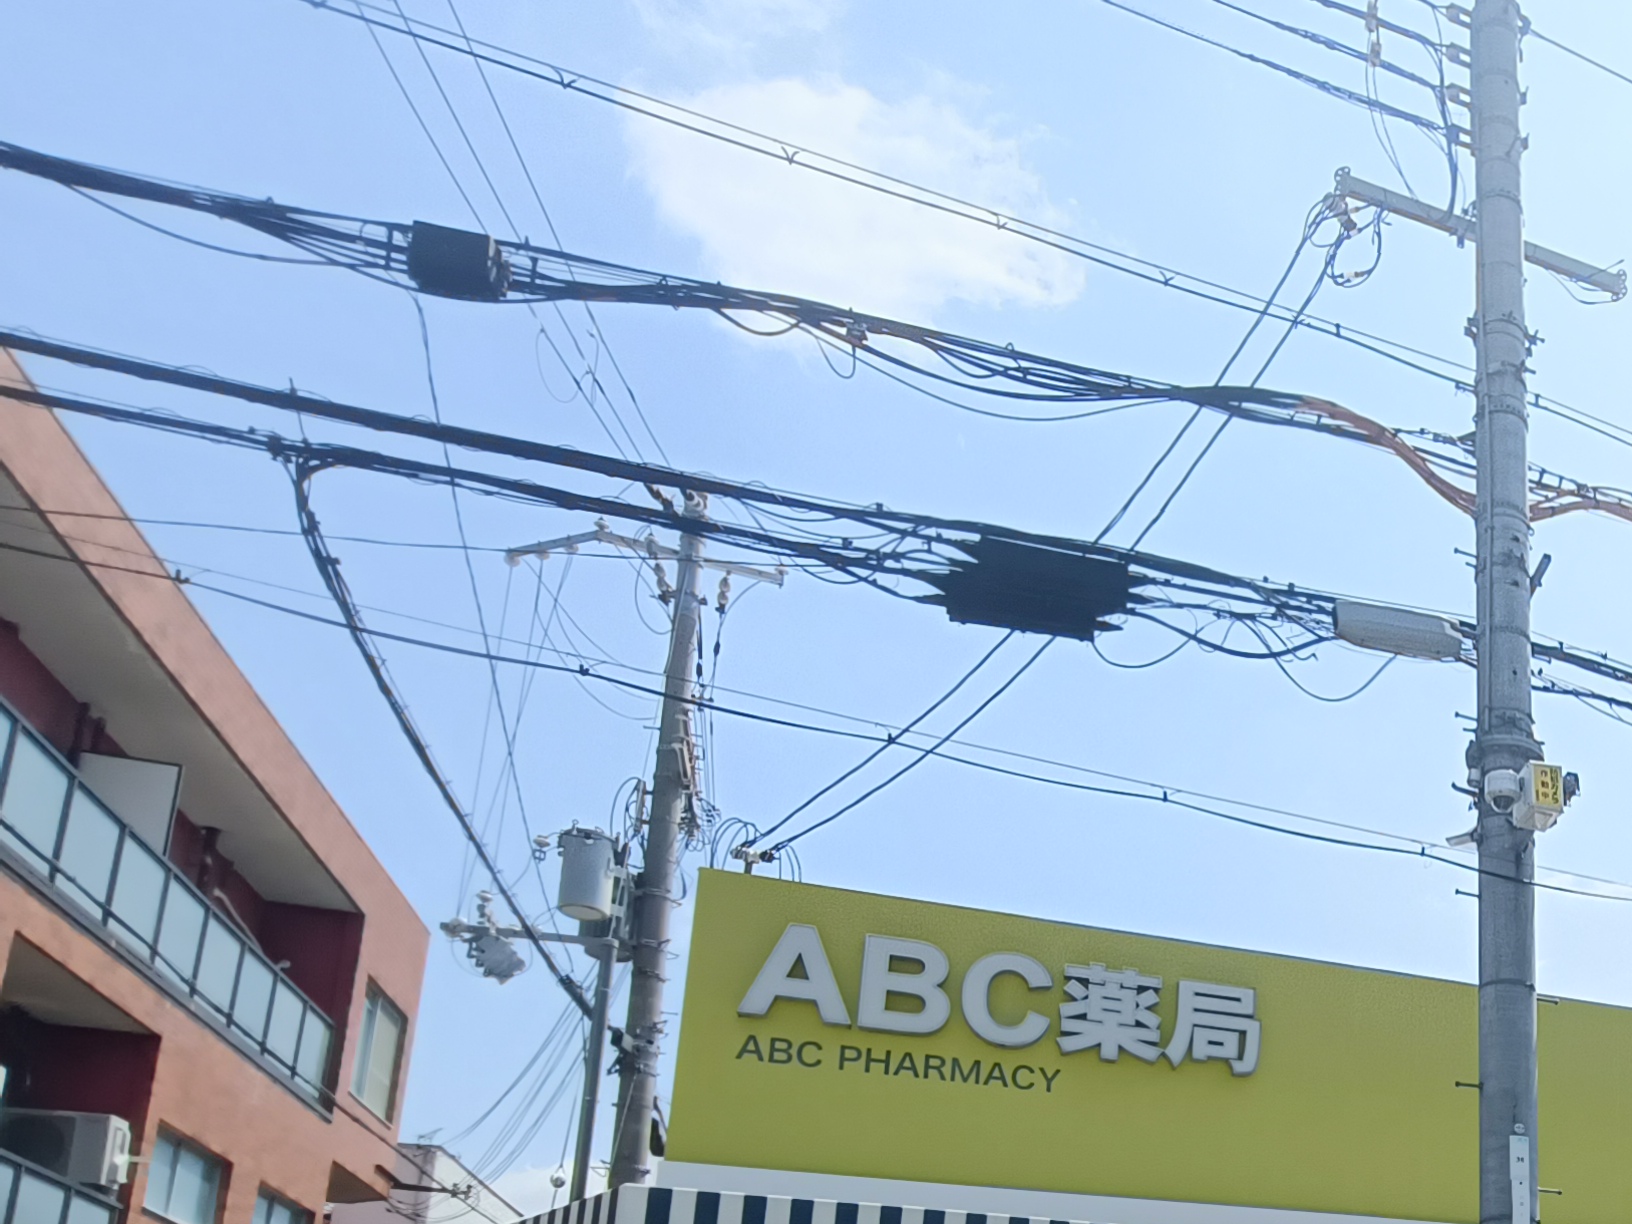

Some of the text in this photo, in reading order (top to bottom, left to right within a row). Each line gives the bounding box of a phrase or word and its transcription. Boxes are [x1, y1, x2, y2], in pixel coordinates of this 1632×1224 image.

[736, 921, 1262, 1078] ABC薬局
[735, 1034, 1062, 1094] ABC PHARMACY
